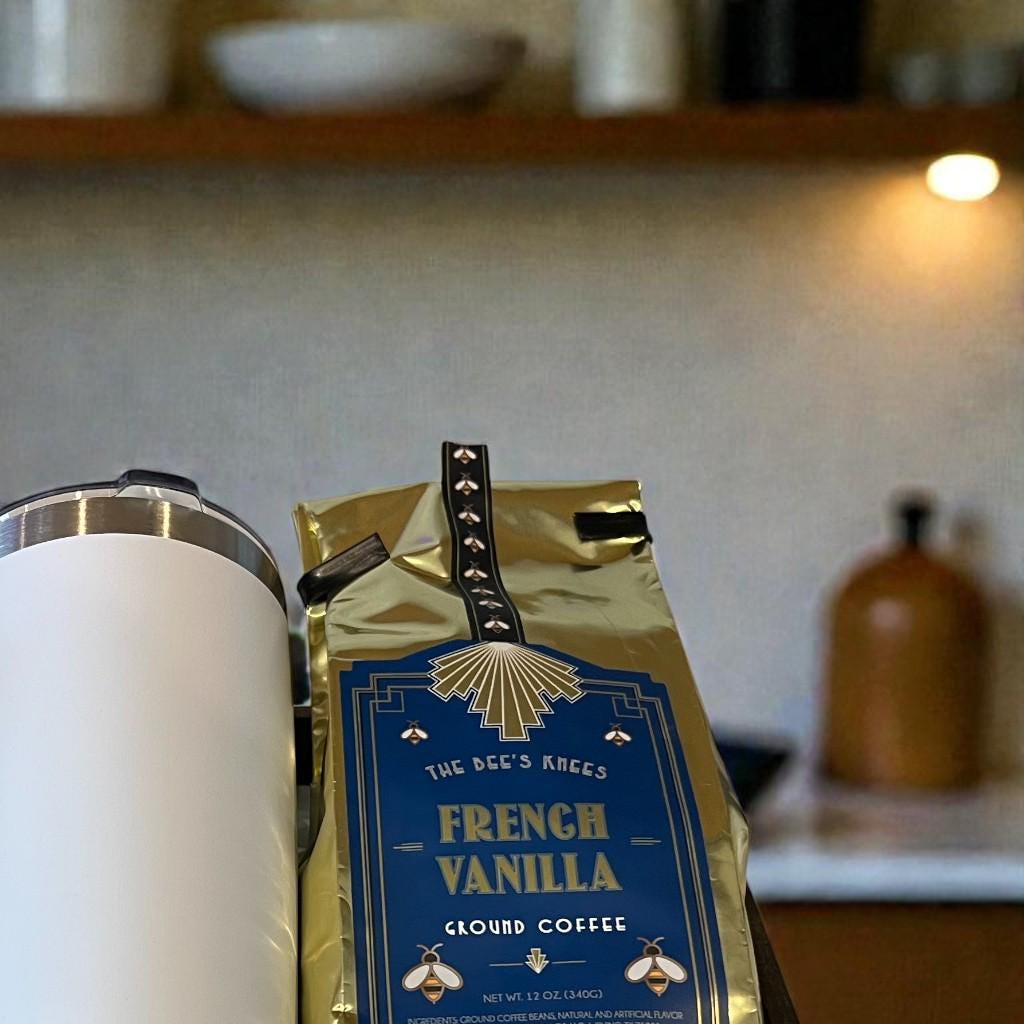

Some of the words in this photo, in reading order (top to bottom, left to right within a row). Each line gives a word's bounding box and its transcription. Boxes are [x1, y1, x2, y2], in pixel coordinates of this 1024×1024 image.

[425, 759, 465, 781] THE
[472, 754, 532, 772] BEE'S
[542, 755, 608, 780] KNEES
[437, 802, 611, 844] FRENCH
[435, 852, 624, 896] VANILLA
[445, 919, 525, 936] GROUND
[538, 916, 626, 934] COFFEE
[482, 993, 503, 1003] NET
[527, 991, 540, 1001] 12
[563, 989, 603, 1000] (340G)
[460, 1015, 495, 1024] GROUND
[497, 1013, 528, 1022] COFFEE
[557, 1010, 593, 1020] NATURAL
[594, 1010, 613, 1019] AND
[613, 1010, 653, 1019] ARTIFICIAL
